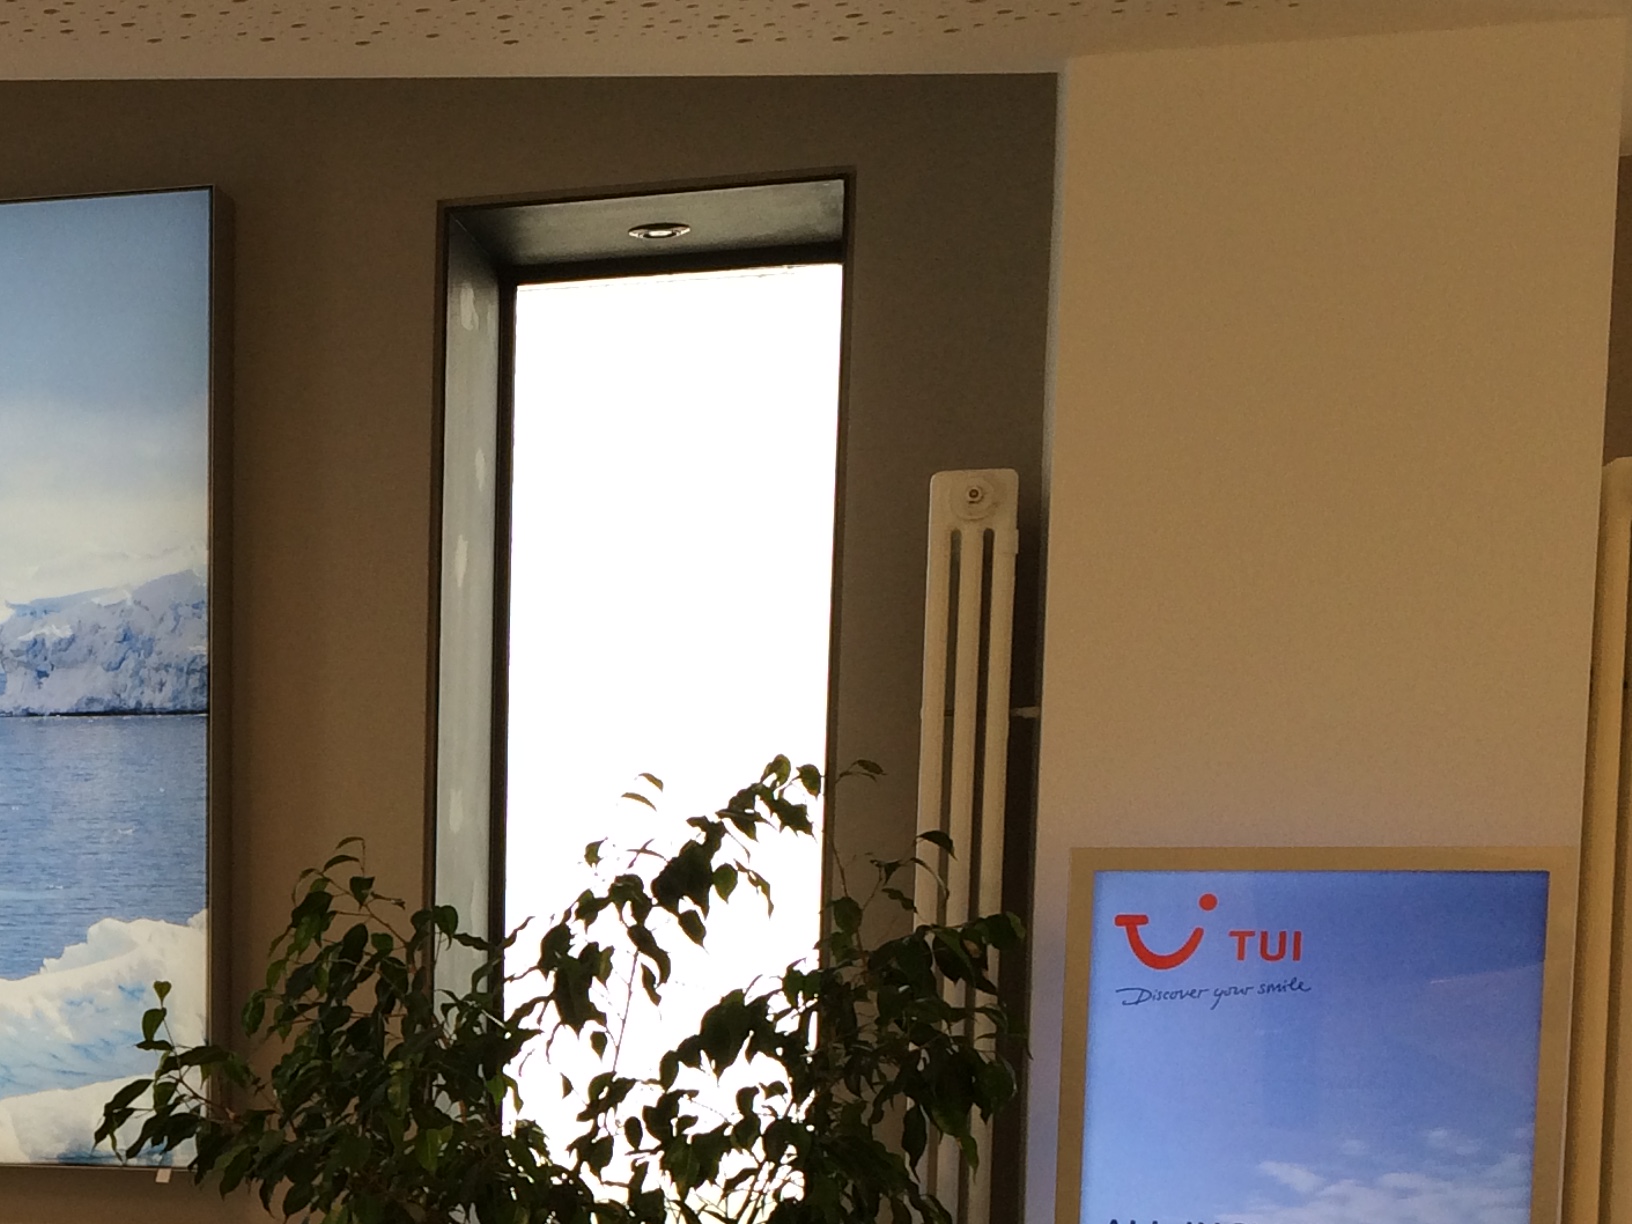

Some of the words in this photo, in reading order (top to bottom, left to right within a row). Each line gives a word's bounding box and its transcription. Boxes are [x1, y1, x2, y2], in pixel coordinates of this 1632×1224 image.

[1228, 930, 1302, 962] TUI
[1115, 987, 1209, 1006] Discover
[1213, 986, 1254, 1010] your
[1257, 977, 1312, 995] smile
